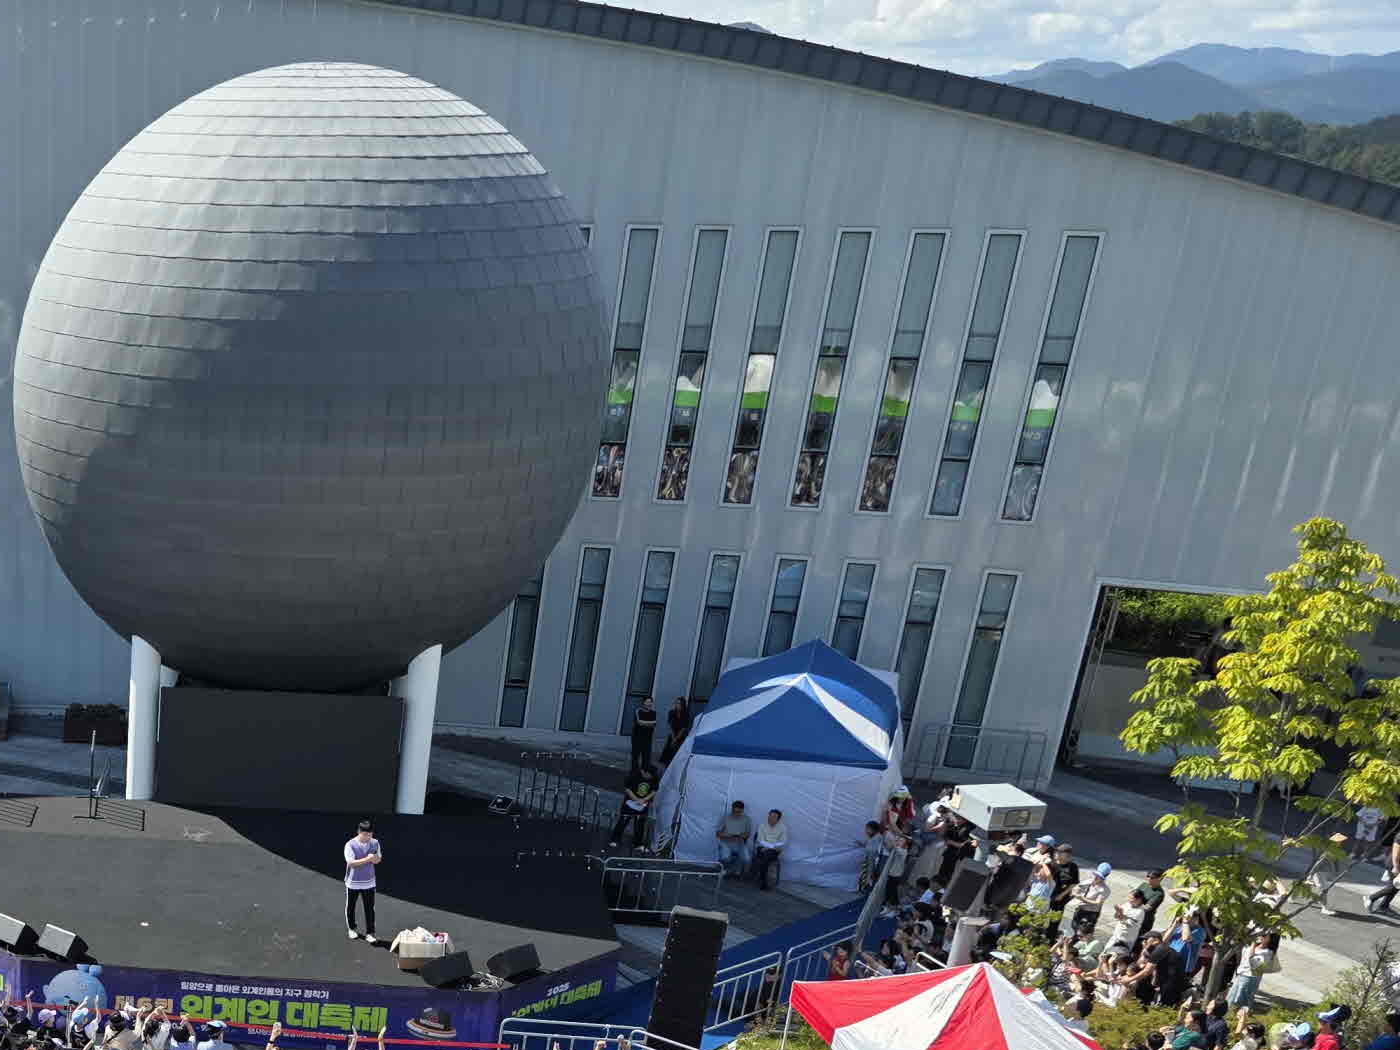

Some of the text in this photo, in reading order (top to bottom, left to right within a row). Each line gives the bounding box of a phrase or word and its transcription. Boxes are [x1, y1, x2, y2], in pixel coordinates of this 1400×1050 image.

[180, 981, 214, 992] 밀양으로
[285, 988, 303, 998] 지구
[546, 981, 571, 997] 2025
[180, 994, 280, 1026] 외계인
[286, 1001, 388, 1033] 대축제
